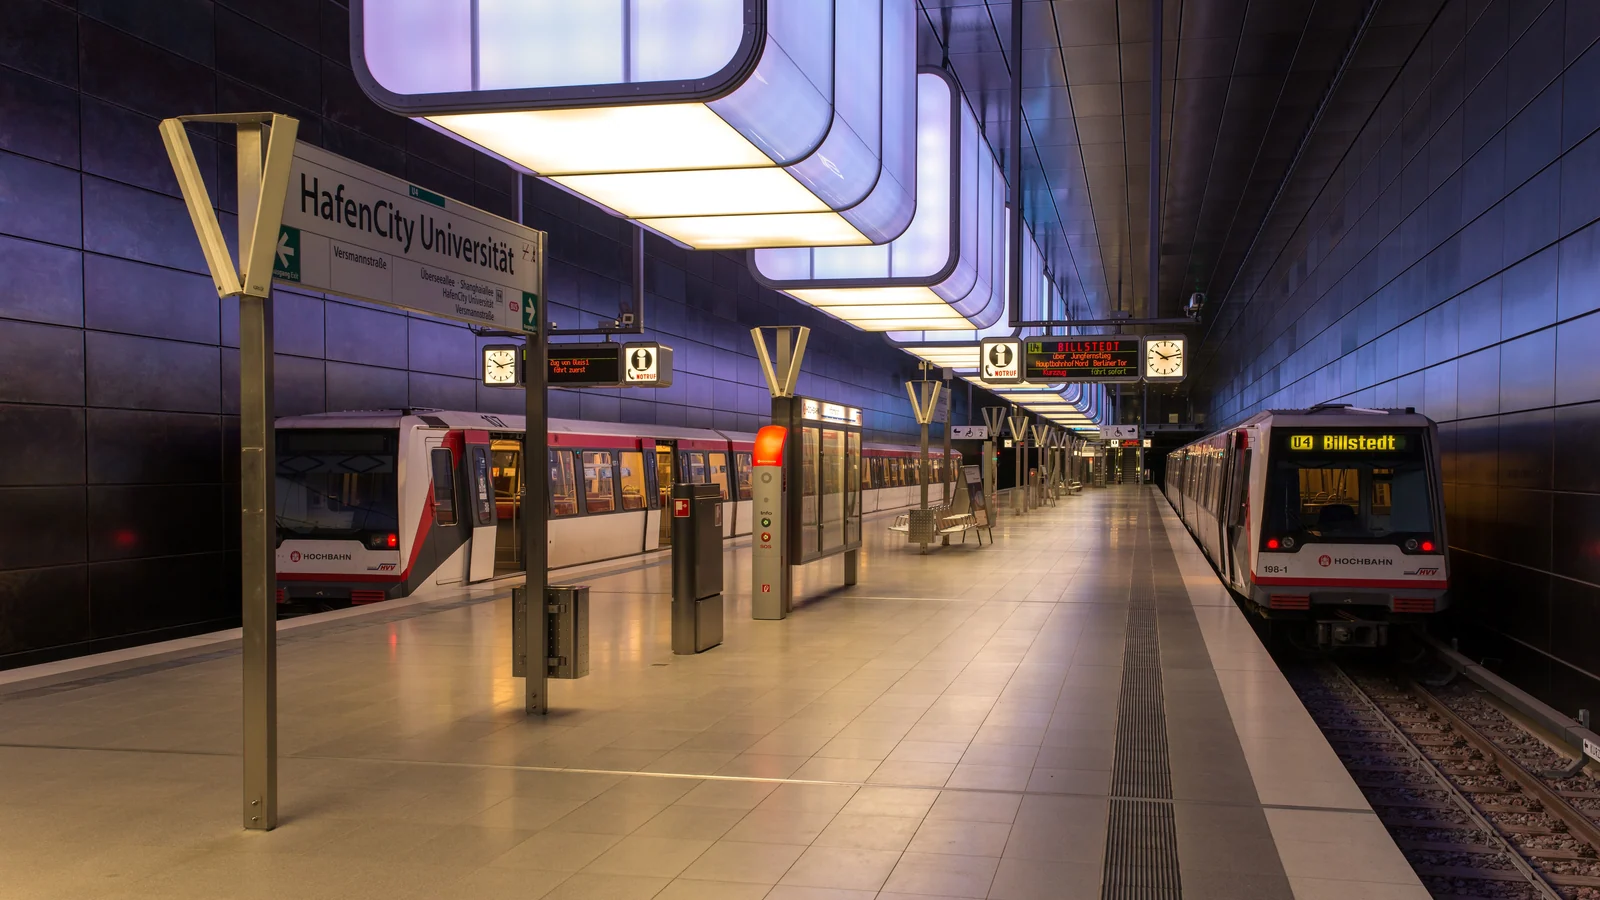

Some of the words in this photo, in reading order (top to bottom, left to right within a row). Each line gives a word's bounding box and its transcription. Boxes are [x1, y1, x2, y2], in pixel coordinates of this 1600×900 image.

[412, 187, 419, 197] U4
[301, 172, 415, 254] HafenCity
[420, 214, 514, 275] Universität
[334, 246, 387, 270] Versmannstraße
[421, 267, 455, 288] Überseeallee
[442, 287, 466, 306] HafenCity
[468, 294, 494, 309] Universität
[455, 304, 494, 321] Versmannstraße
[1030, 343, 1040, 352] U4
[1058, 341, 1120, 352] BILLSTEDT
[1042, 369, 1067, 377] Kurzzug
[1293, 436, 1310, 448] U4
[1323, 435, 1396, 450] Billstedt
[1334, 557, 1393, 566] HOCHBAHN
